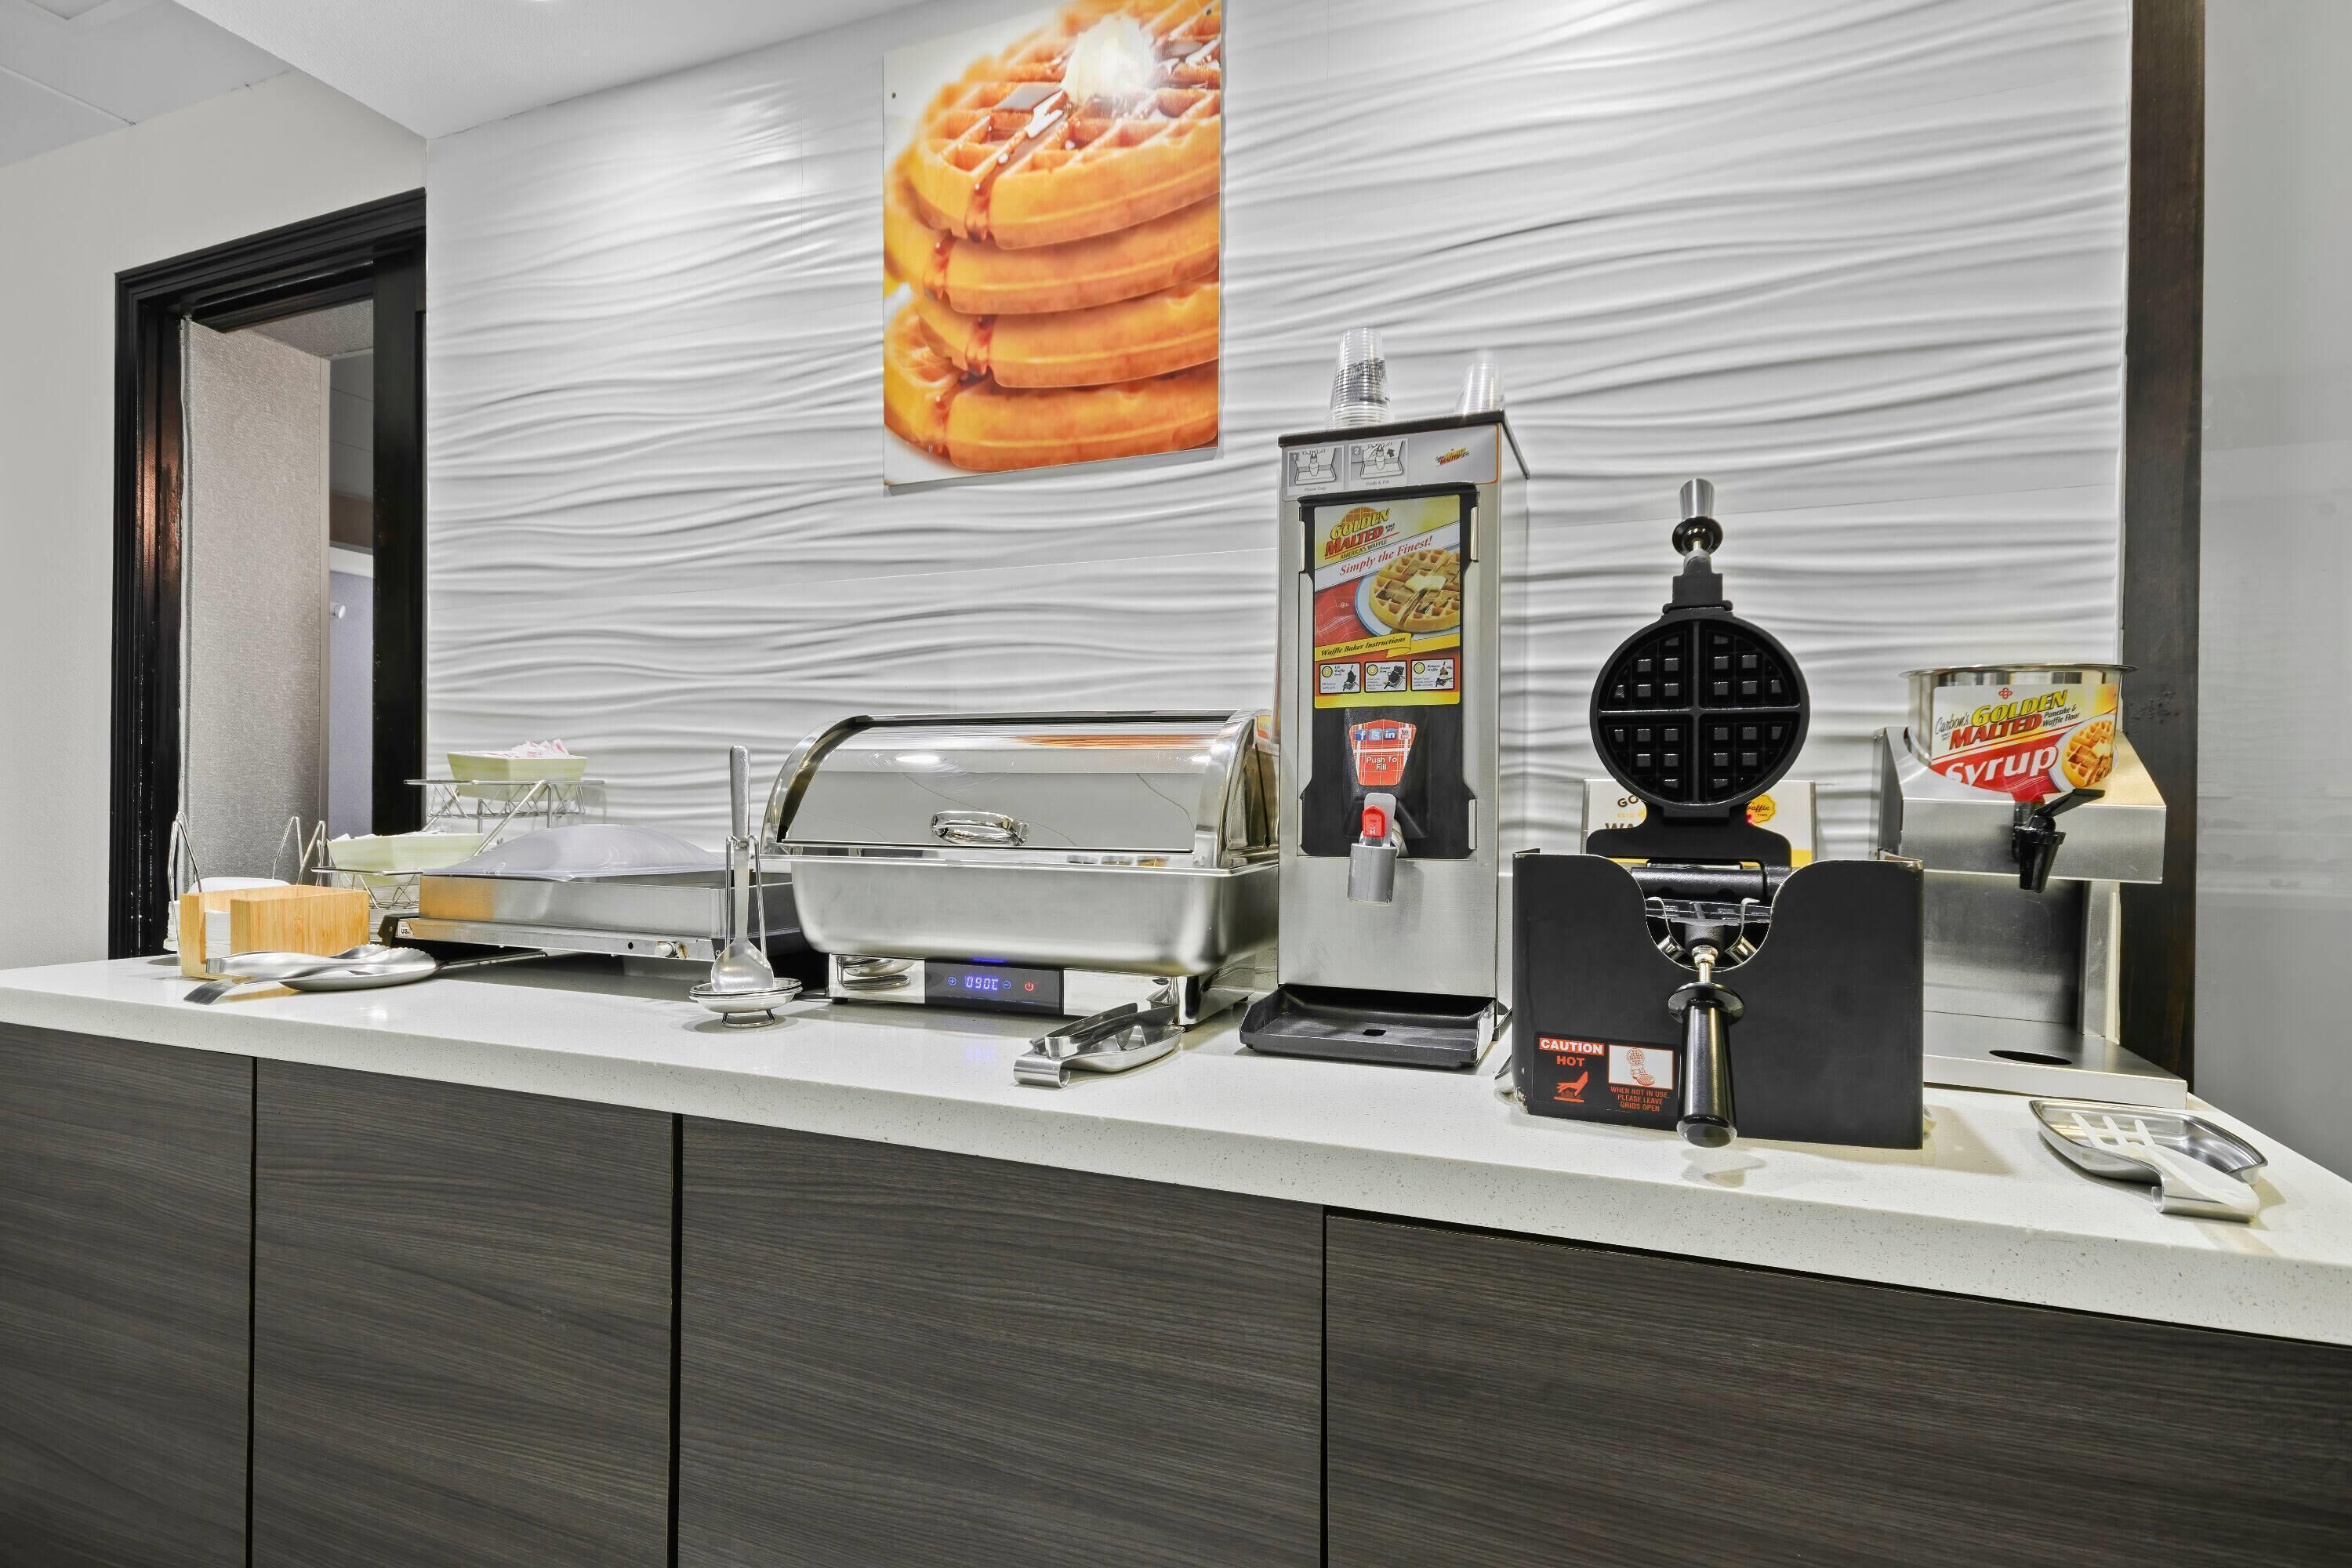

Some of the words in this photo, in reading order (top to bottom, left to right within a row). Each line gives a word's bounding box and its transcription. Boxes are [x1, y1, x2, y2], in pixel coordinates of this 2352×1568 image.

[1330, 507, 1391, 540] GOLDEN
[1325, 525, 1385, 557] MALTED
[1340, 546, 1367, 560] AMERICA'S
[1367, 539, 1388, 550] WAFFLE
[1339, 554, 1376, 575] Simply
[1377, 550, 1395, 563] the
[1396, 535, 1433, 557] Finest!
[1320, 647, 1343, 656] Waffle
[1344, 643, 1364, 652] Baker
[1365, 636, 1406, 648] Instructions
[1972, 689, 2068, 727] GOLDEN
[2044, 707, 2071, 719] Pancake
[2042, 716, 2064, 727] Waffle
[2065, 713, 2081, 722] Flour
[1949, 713, 2044, 750] MALTED
[1945, 744, 2059, 786] Syrup
[1541, 1039, 1603, 1054] CAUTION
[1556, 1055, 1585, 1067] HOT
[1610, 1086, 1630, 1094] WHEN
[1617, 1094, 1642, 1102] PLEASE
[1620, 1101, 1640, 1110] GRIDS
[1642, 1103, 1661, 1112] OPEN
